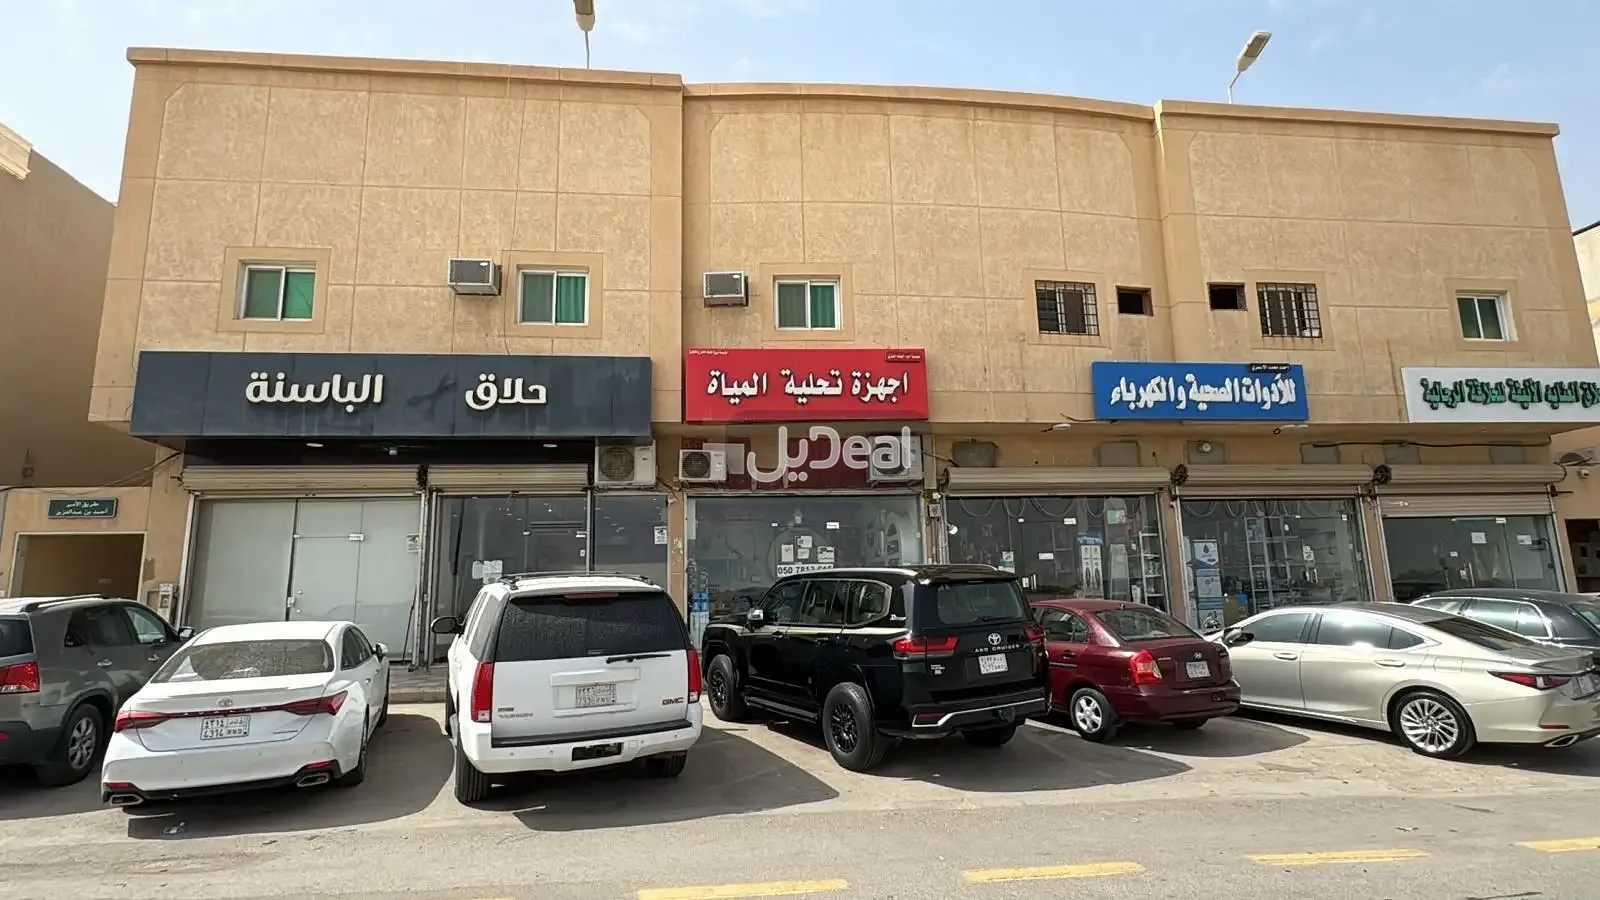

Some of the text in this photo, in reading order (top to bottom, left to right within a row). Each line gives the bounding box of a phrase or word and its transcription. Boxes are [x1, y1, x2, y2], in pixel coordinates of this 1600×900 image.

[245, 371, 548, 414] حلاق الباسنة
[707, 369, 908, 405] اجهزة تحلية المياة
[1185, 373, 1239, 411] الصحية
[777, 566, 793, 575] 050
[662, 697, 684, 706] GMC
